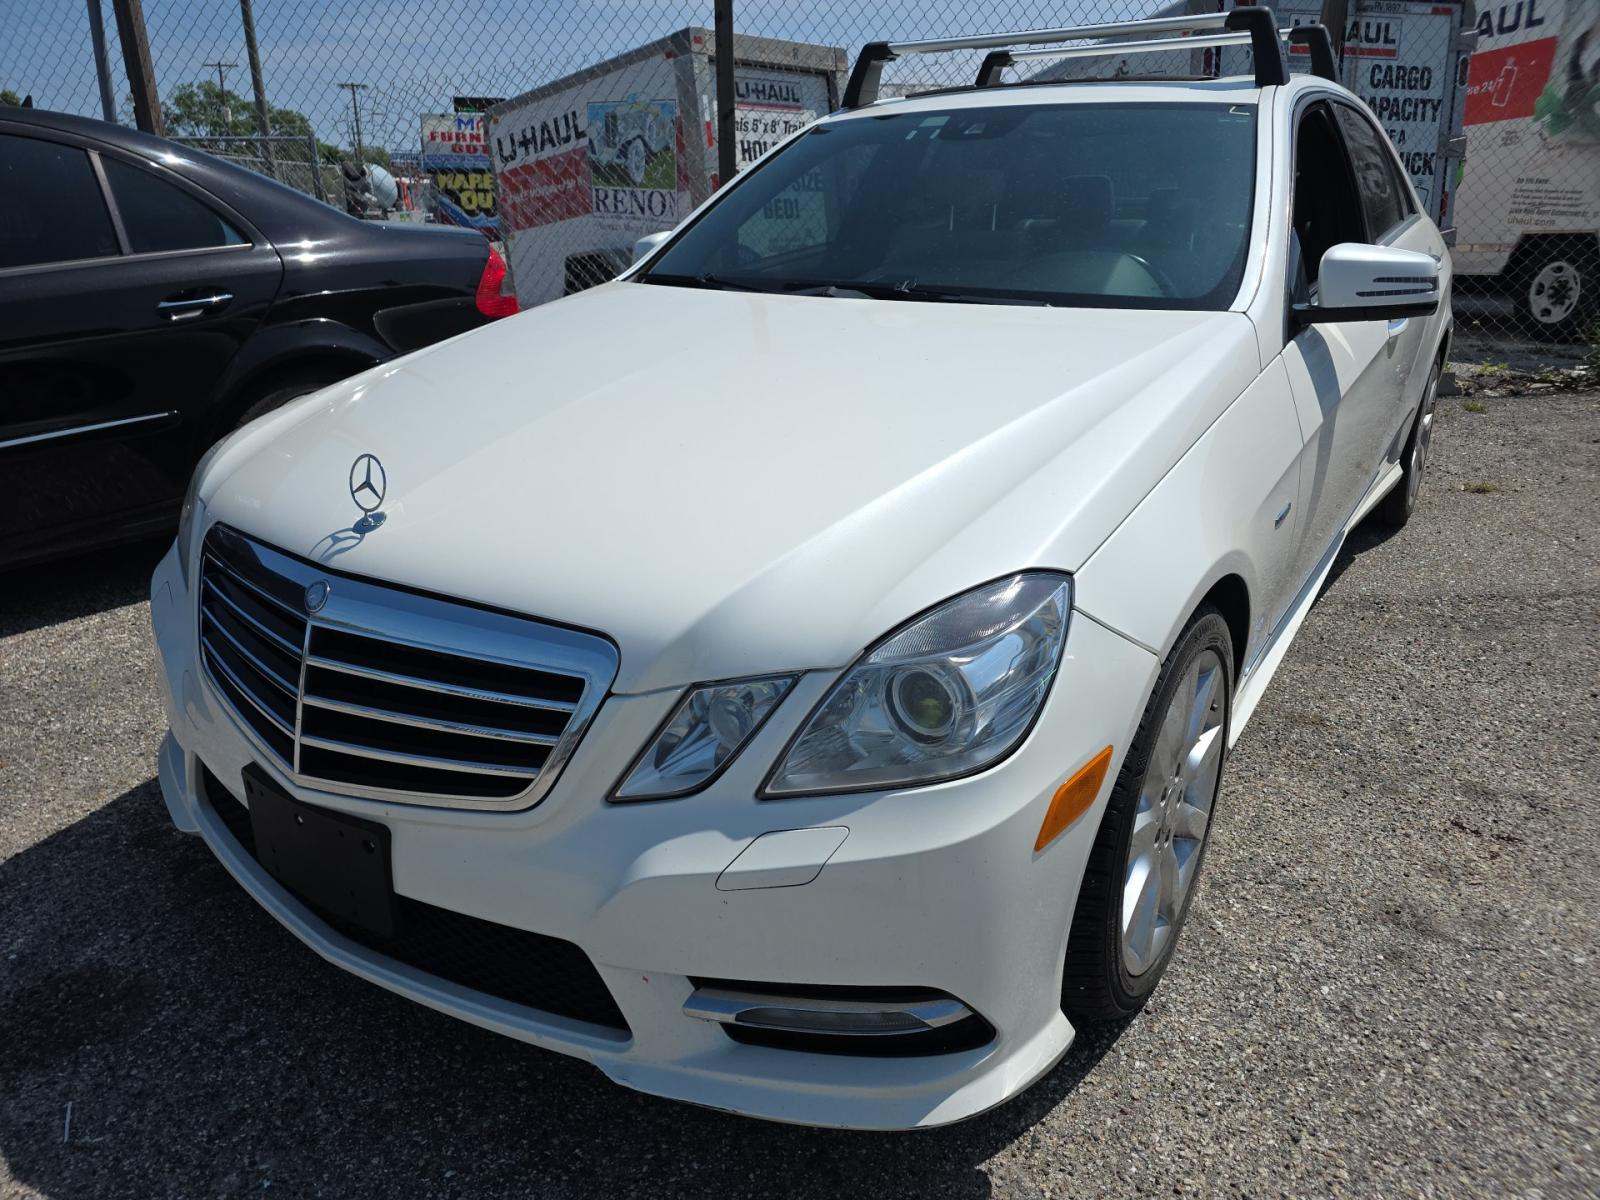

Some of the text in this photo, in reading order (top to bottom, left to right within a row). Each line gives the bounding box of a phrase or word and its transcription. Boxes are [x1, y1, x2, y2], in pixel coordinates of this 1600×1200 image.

[1347, 20, 1397, 44] AUL
[1369, 63, 1432, 91] CARGO
[1360, 95, 1443, 123] APACITY
[496, 110, 588, 164] U-HAUL
